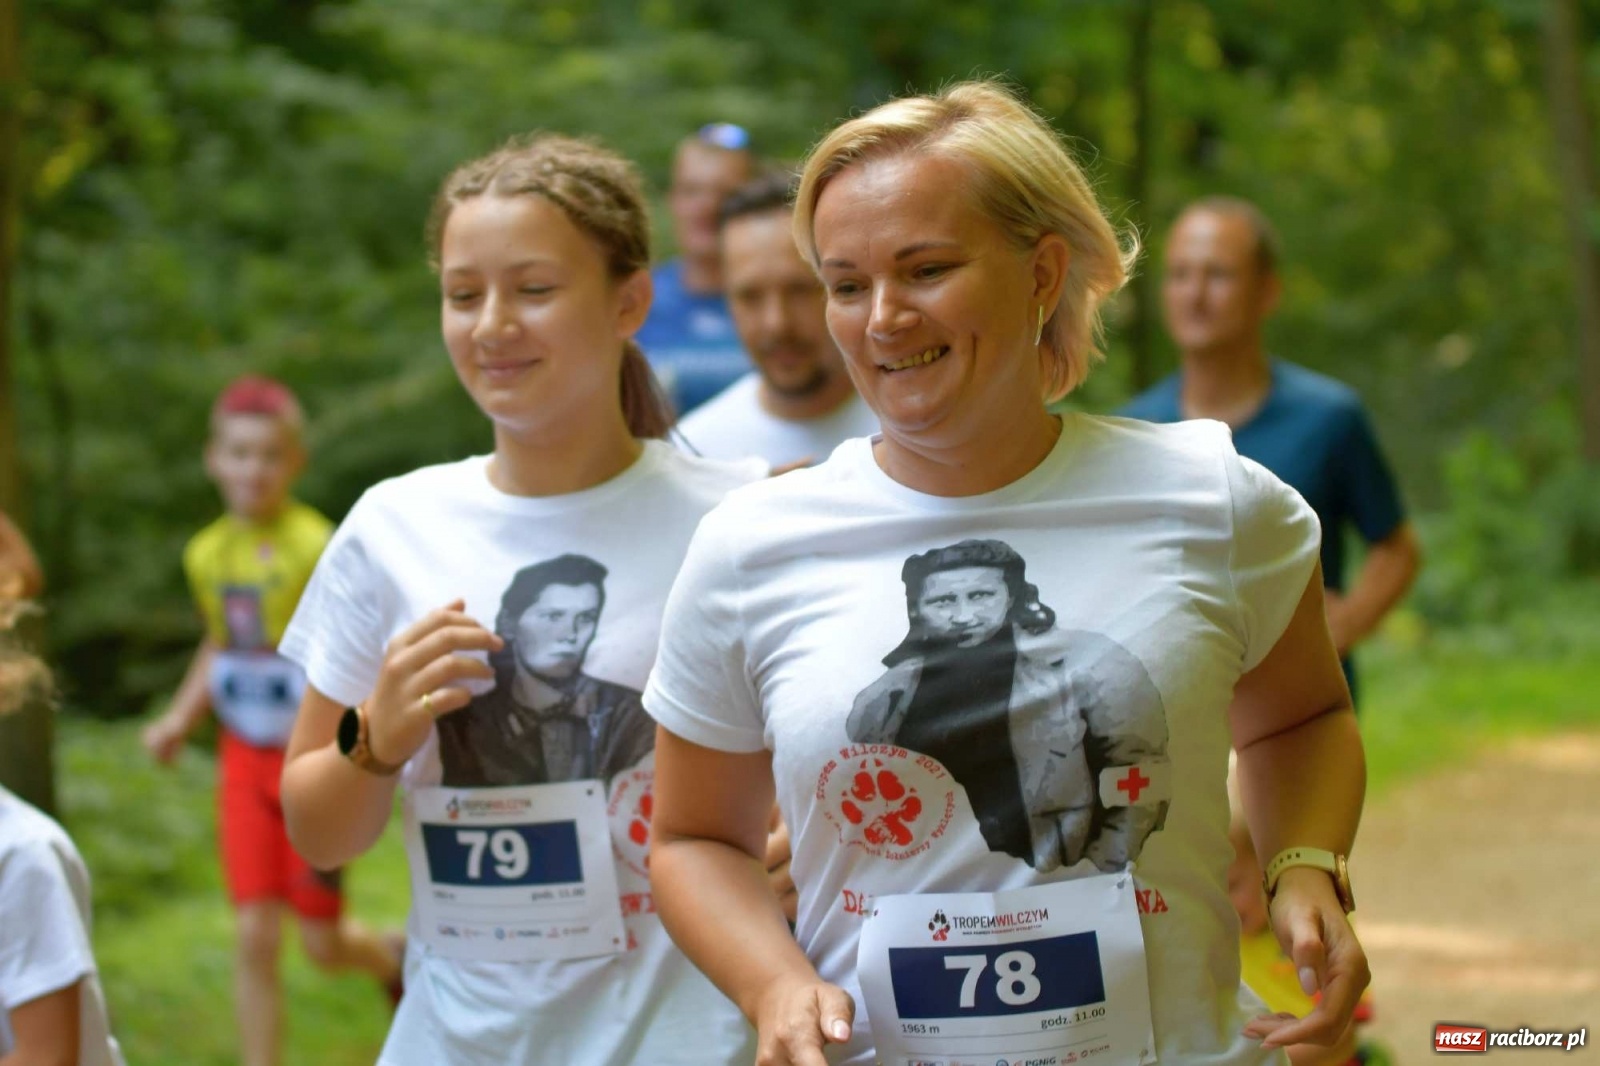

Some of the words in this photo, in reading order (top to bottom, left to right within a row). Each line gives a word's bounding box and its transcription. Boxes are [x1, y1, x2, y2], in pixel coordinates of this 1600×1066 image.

[840, 744, 908, 760] Wilczym
[915, 755, 946, 779] 2021
[456, 829, 530, 880] 79
[943, 950, 1041, 1008] 78
[902, 1023, 927, 1034] 1963
[929, 1025, 940, 1034] m
[1041, 1015, 1072, 1030] godz.
[1075, 1007, 1106, 1023] 11.00
